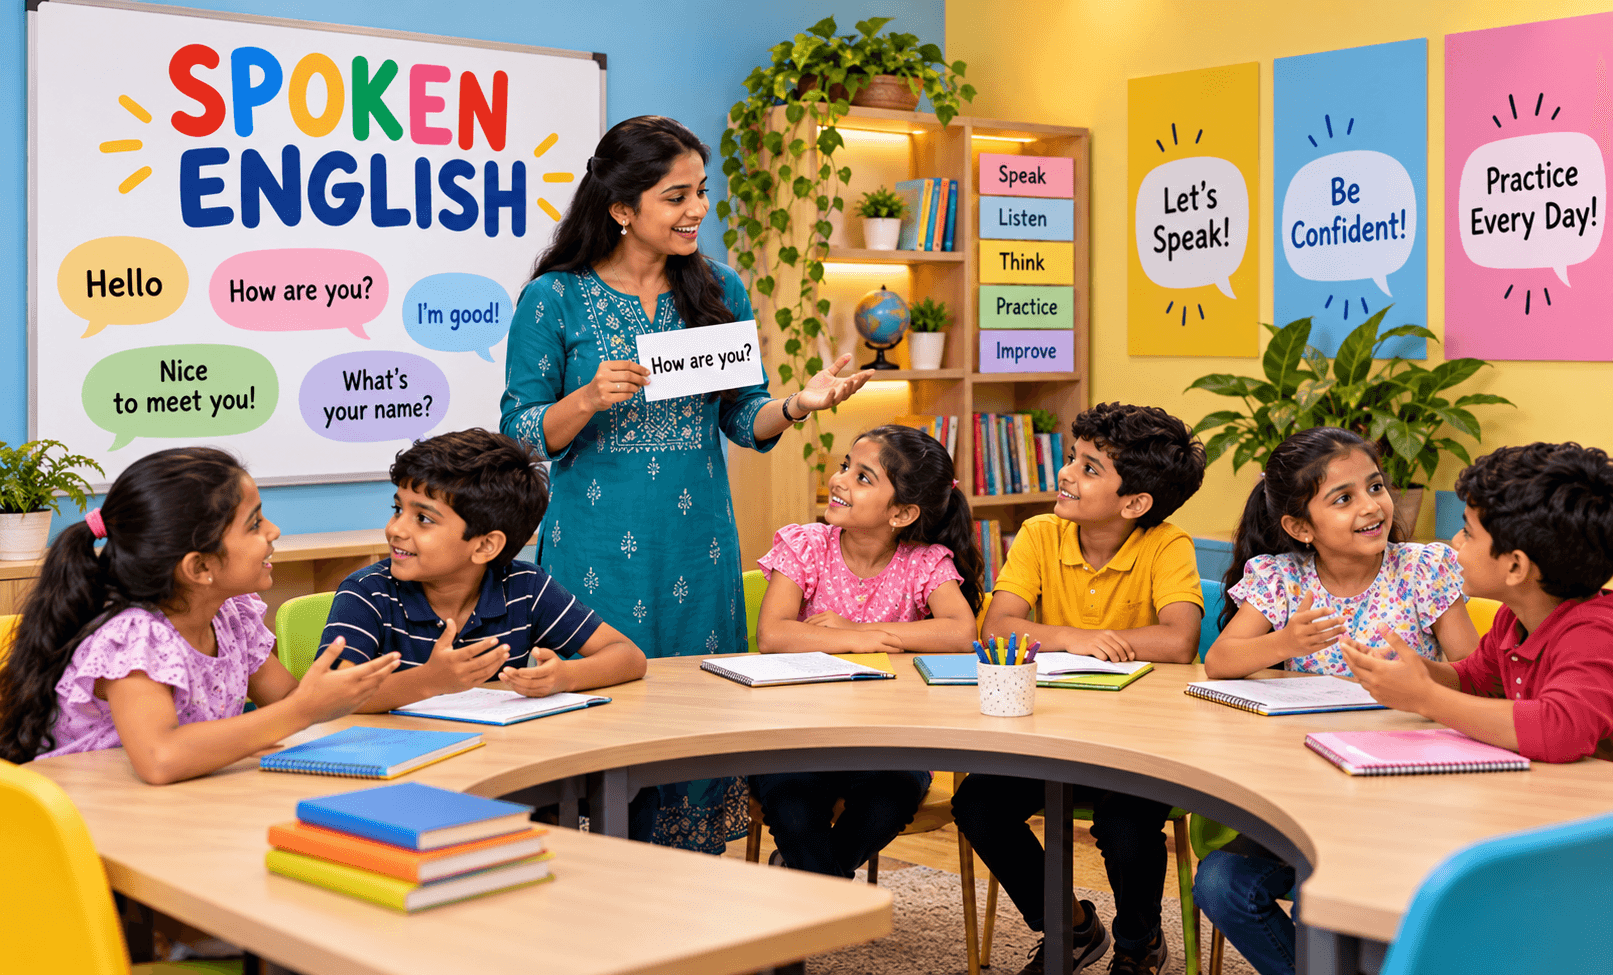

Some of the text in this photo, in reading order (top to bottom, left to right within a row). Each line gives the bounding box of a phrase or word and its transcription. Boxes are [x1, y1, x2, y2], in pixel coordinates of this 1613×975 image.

[168, 44, 508, 151] SPOKEN
[180, 144, 526, 237] ENGLISH
[999, 165, 1046, 188] Speak
[1331, 177, 1360, 206] Be
[1487, 162, 1578, 194] Practice
[1165, 181, 1217, 214] Let's
[1000, 208, 1046, 227] Listen
[1292, 209, 1405, 248] Confident!
[1472, 196, 1596, 240] Every Day!
[1153, 217, 1229, 261] Speak!
[999, 252, 1045, 270] Think
[87, 268, 162, 298] Hello
[230, 276, 373, 307] How are you?
[418, 302, 498, 330] I'm good!
[997, 297, 1057, 315] Practice
[651, 343, 751, 374] How are you?
[997, 342, 1056, 364] Improve
[161, 360, 207, 382] Nice
[343, 368, 407, 391] What's
[113, 386, 254, 417] to meet you!
[324, 395, 432, 428] your name?
